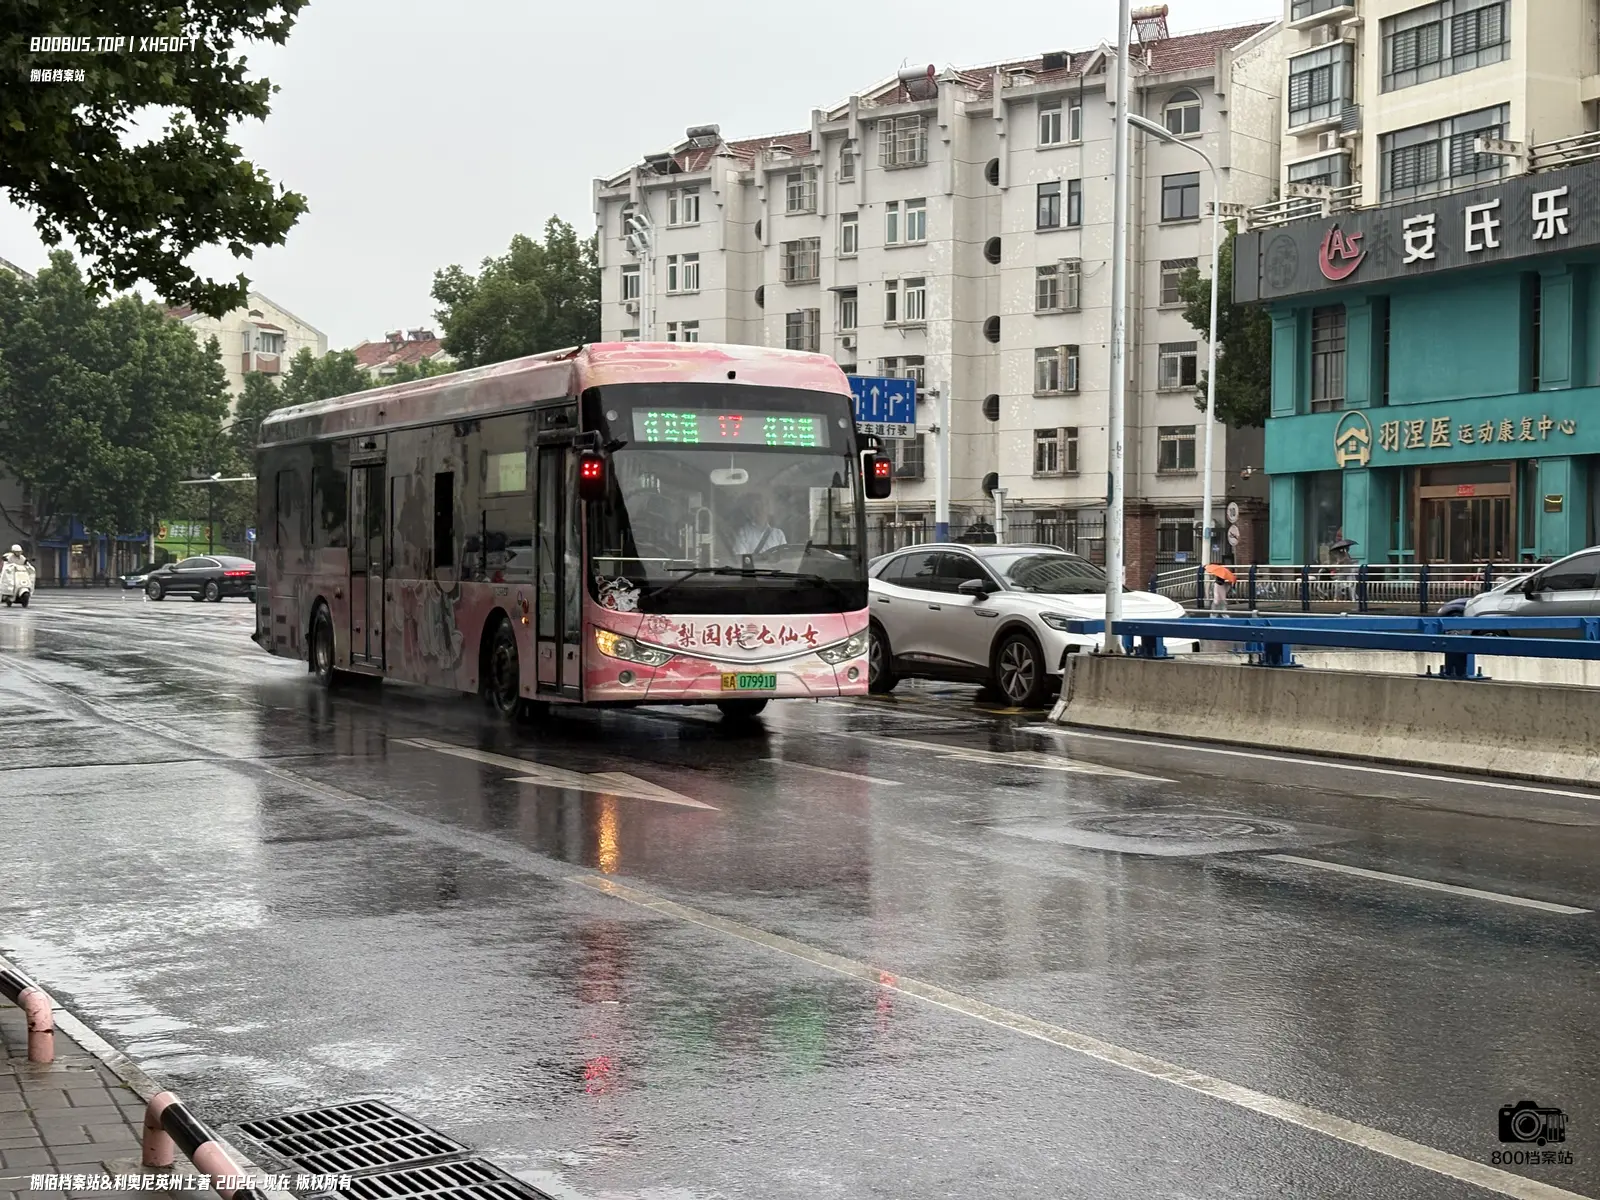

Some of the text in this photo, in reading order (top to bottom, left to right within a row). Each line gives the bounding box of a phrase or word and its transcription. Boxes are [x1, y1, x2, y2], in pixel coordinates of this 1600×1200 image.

[1402, 185, 1569, 264] 安氏乐
[1378, 414, 1576, 452] 羽涅医 运动康复中心
[677, 622, 746, 647] 梨园线
[757, 622, 820, 647] 七仙女
